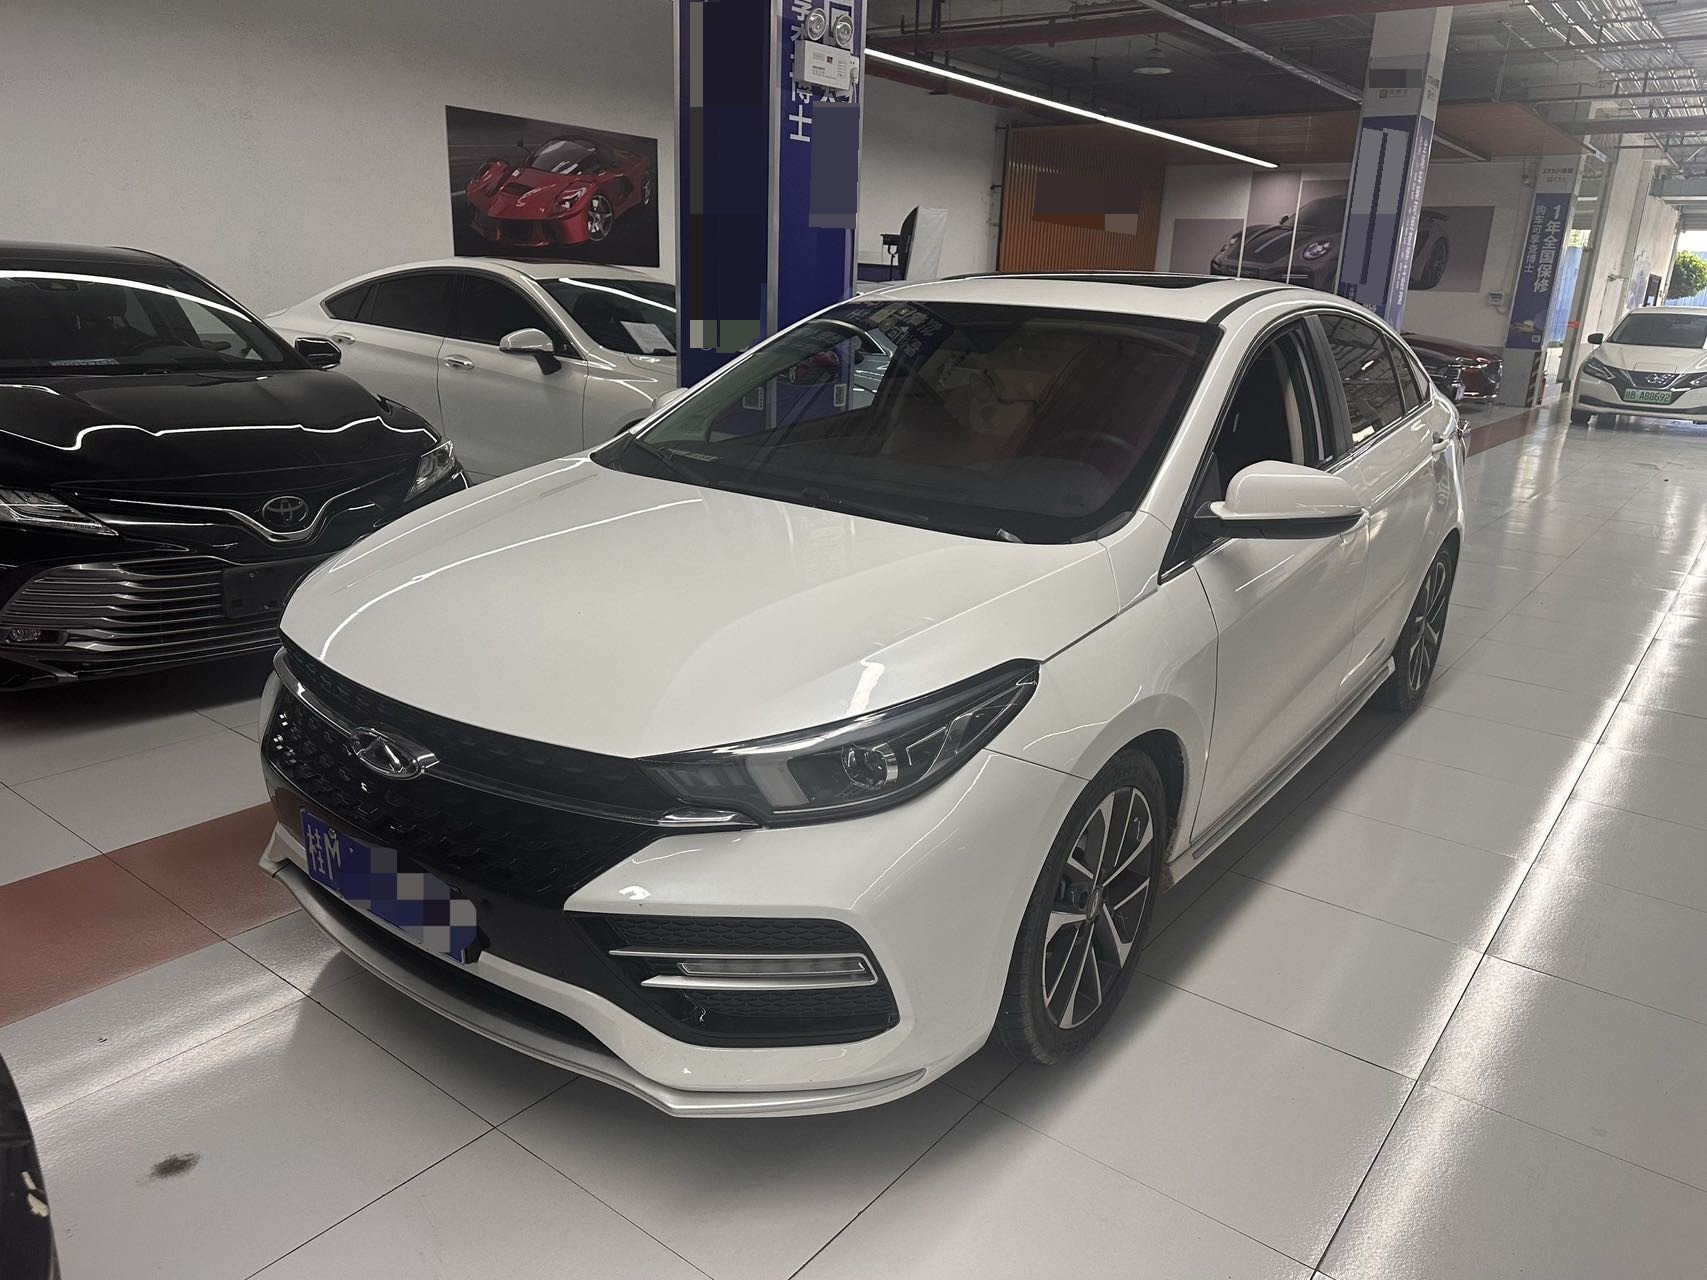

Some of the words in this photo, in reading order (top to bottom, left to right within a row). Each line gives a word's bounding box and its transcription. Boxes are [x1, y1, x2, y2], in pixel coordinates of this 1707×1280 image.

[1533, 204, 1561, 293] 1年全国保修
